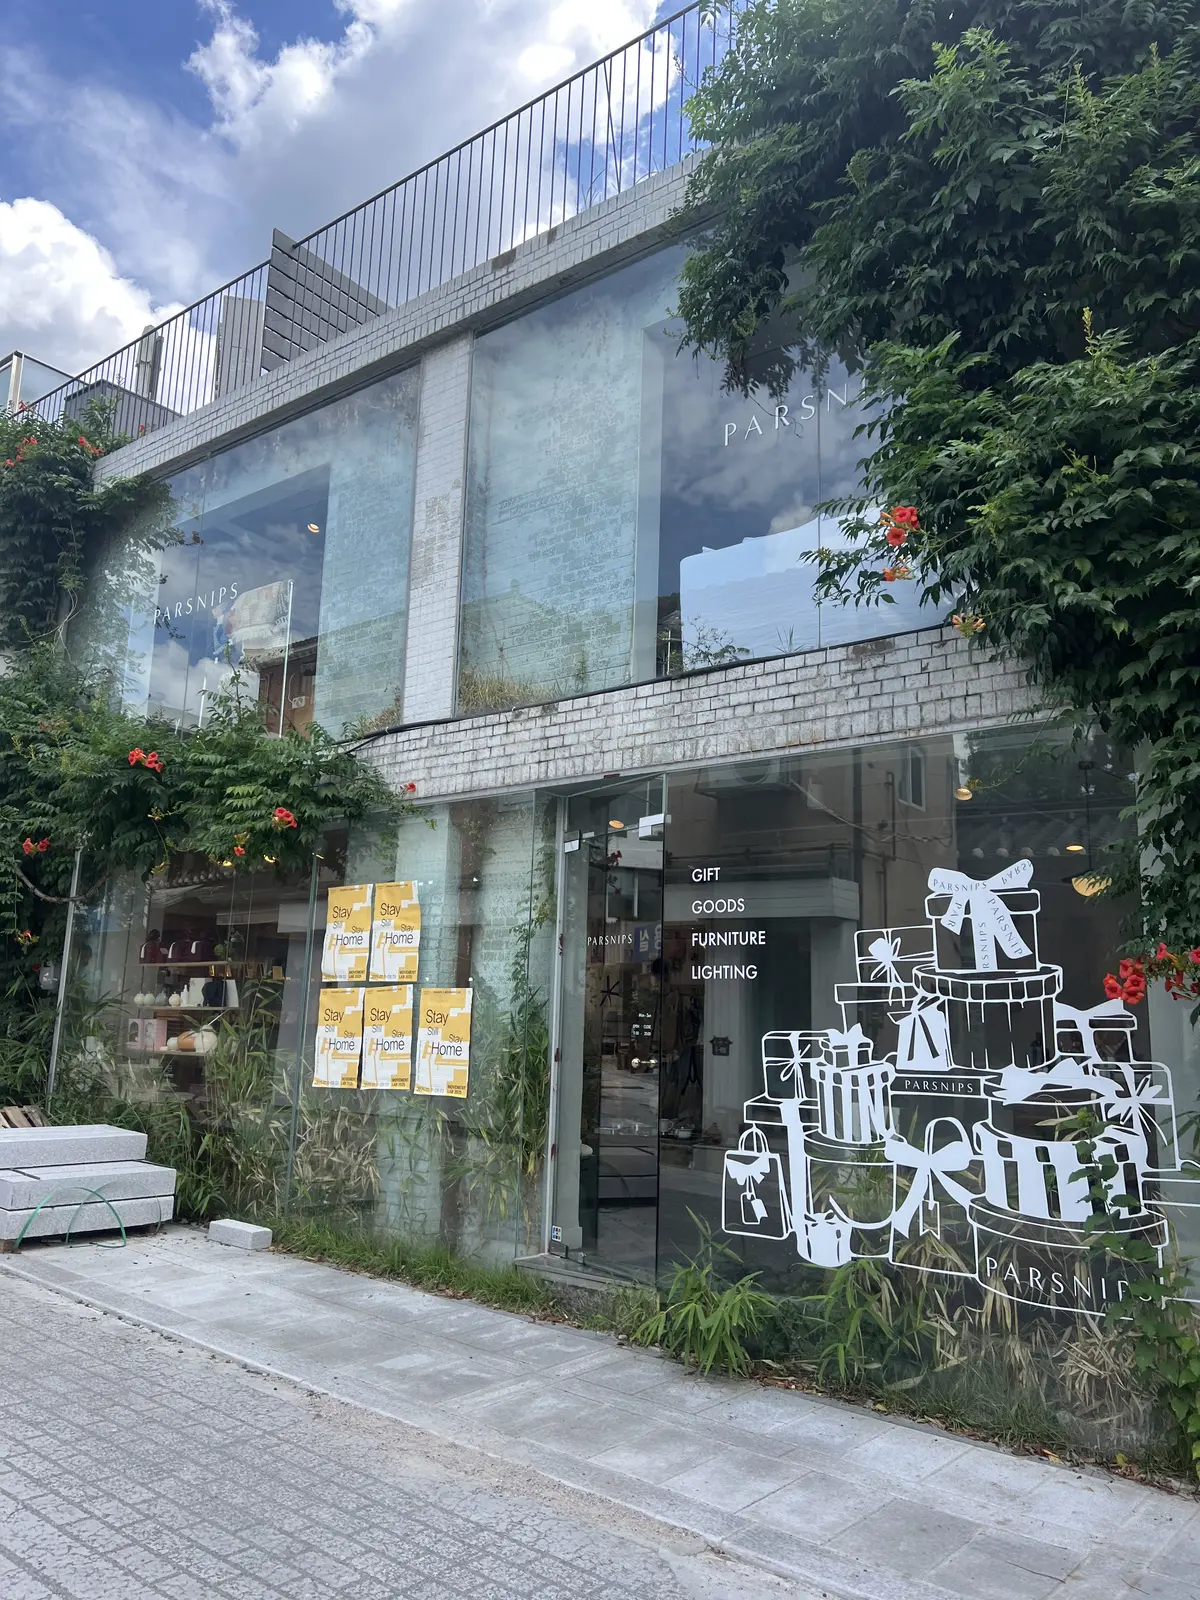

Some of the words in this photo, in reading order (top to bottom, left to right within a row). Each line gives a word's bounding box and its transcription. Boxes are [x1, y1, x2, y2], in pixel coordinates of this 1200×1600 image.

[152, 582, 239, 625] PARSNIPS
[691, 867, 721, 883] GIFT
[933, 879, 987, 892] PARSNIPS
[332, 906, 352, 920] Stay
[380, 902, 401, 918] Stay
[691, 898, 746, 915] GOODS
[351, 926, 364, 934] Stay
[400, 924, 414, 933] Stay
[987, 898, 1023, 955] PARSNIP
[336, 934, 363, 946] Home
[385, 932, 414, 944] Home
[587, 933, 633, 947] PARSNIPS
[691, 930, 767, 947] FURNITURE
[979, 922, 990, 969] RSNIPS
[691, 964, 759, 981] LIGHTING
[324, 1008, 344, 1023] Stay
[370, 1008, 391, 1023] Stay
[426, 1009, 449, 1026] Stay
[344, 1030, 356, 1039] Stay
[392, 1030, 405, 1039] Stay
[448, 1034, 463, 1045] Stay
[329, 1038, 355, 1050] Home
[376, 1038, 405, 1051] Home
[431, 1042, 462, 1057] Home
[904, 1079, 973, 1093] PARSNIPS
[986, 1257, 1152, 1302] PARSNIP
